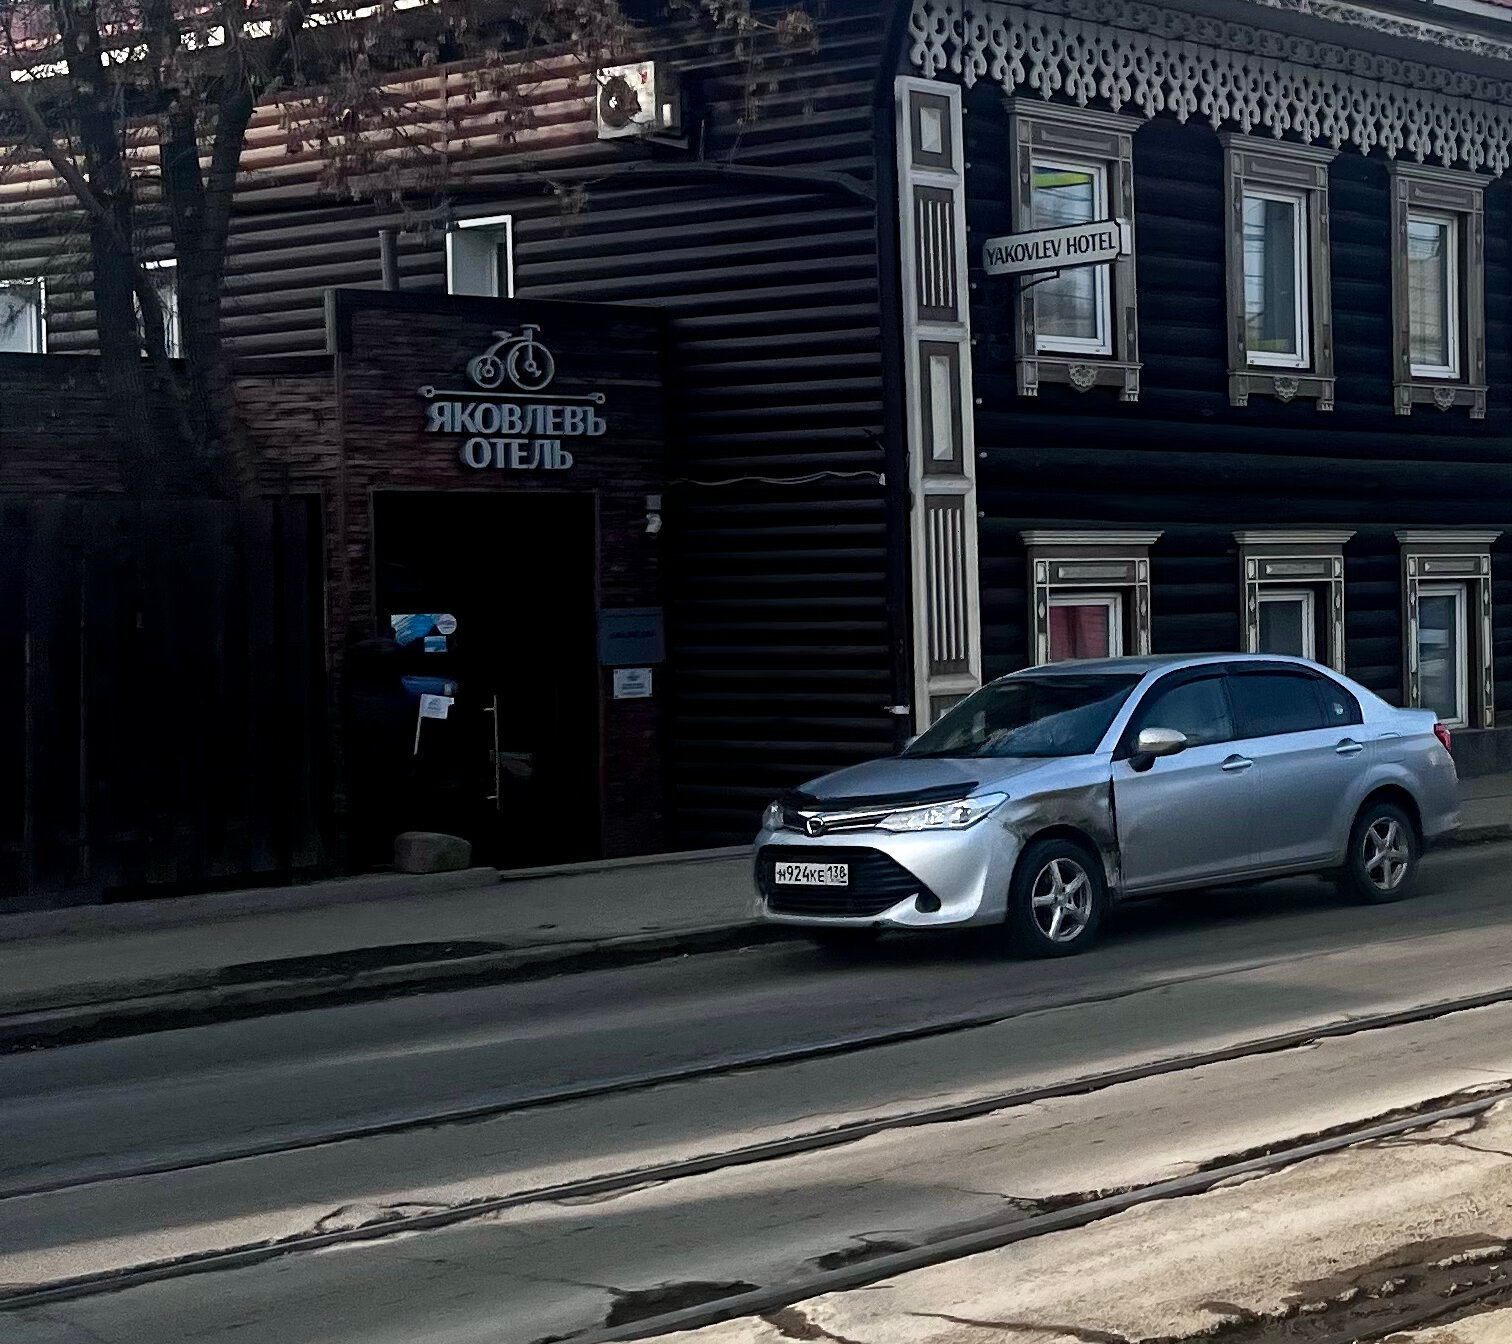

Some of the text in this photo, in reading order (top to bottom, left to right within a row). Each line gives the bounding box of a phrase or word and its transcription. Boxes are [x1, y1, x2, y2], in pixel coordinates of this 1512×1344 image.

[986, 231, 1116, 266] YAKOVLEV HOTEL
[425, 401, 607, 436] ЯКОВЛЕВЪ
[462, 437, 574, 470] ОТЕЛЬ
